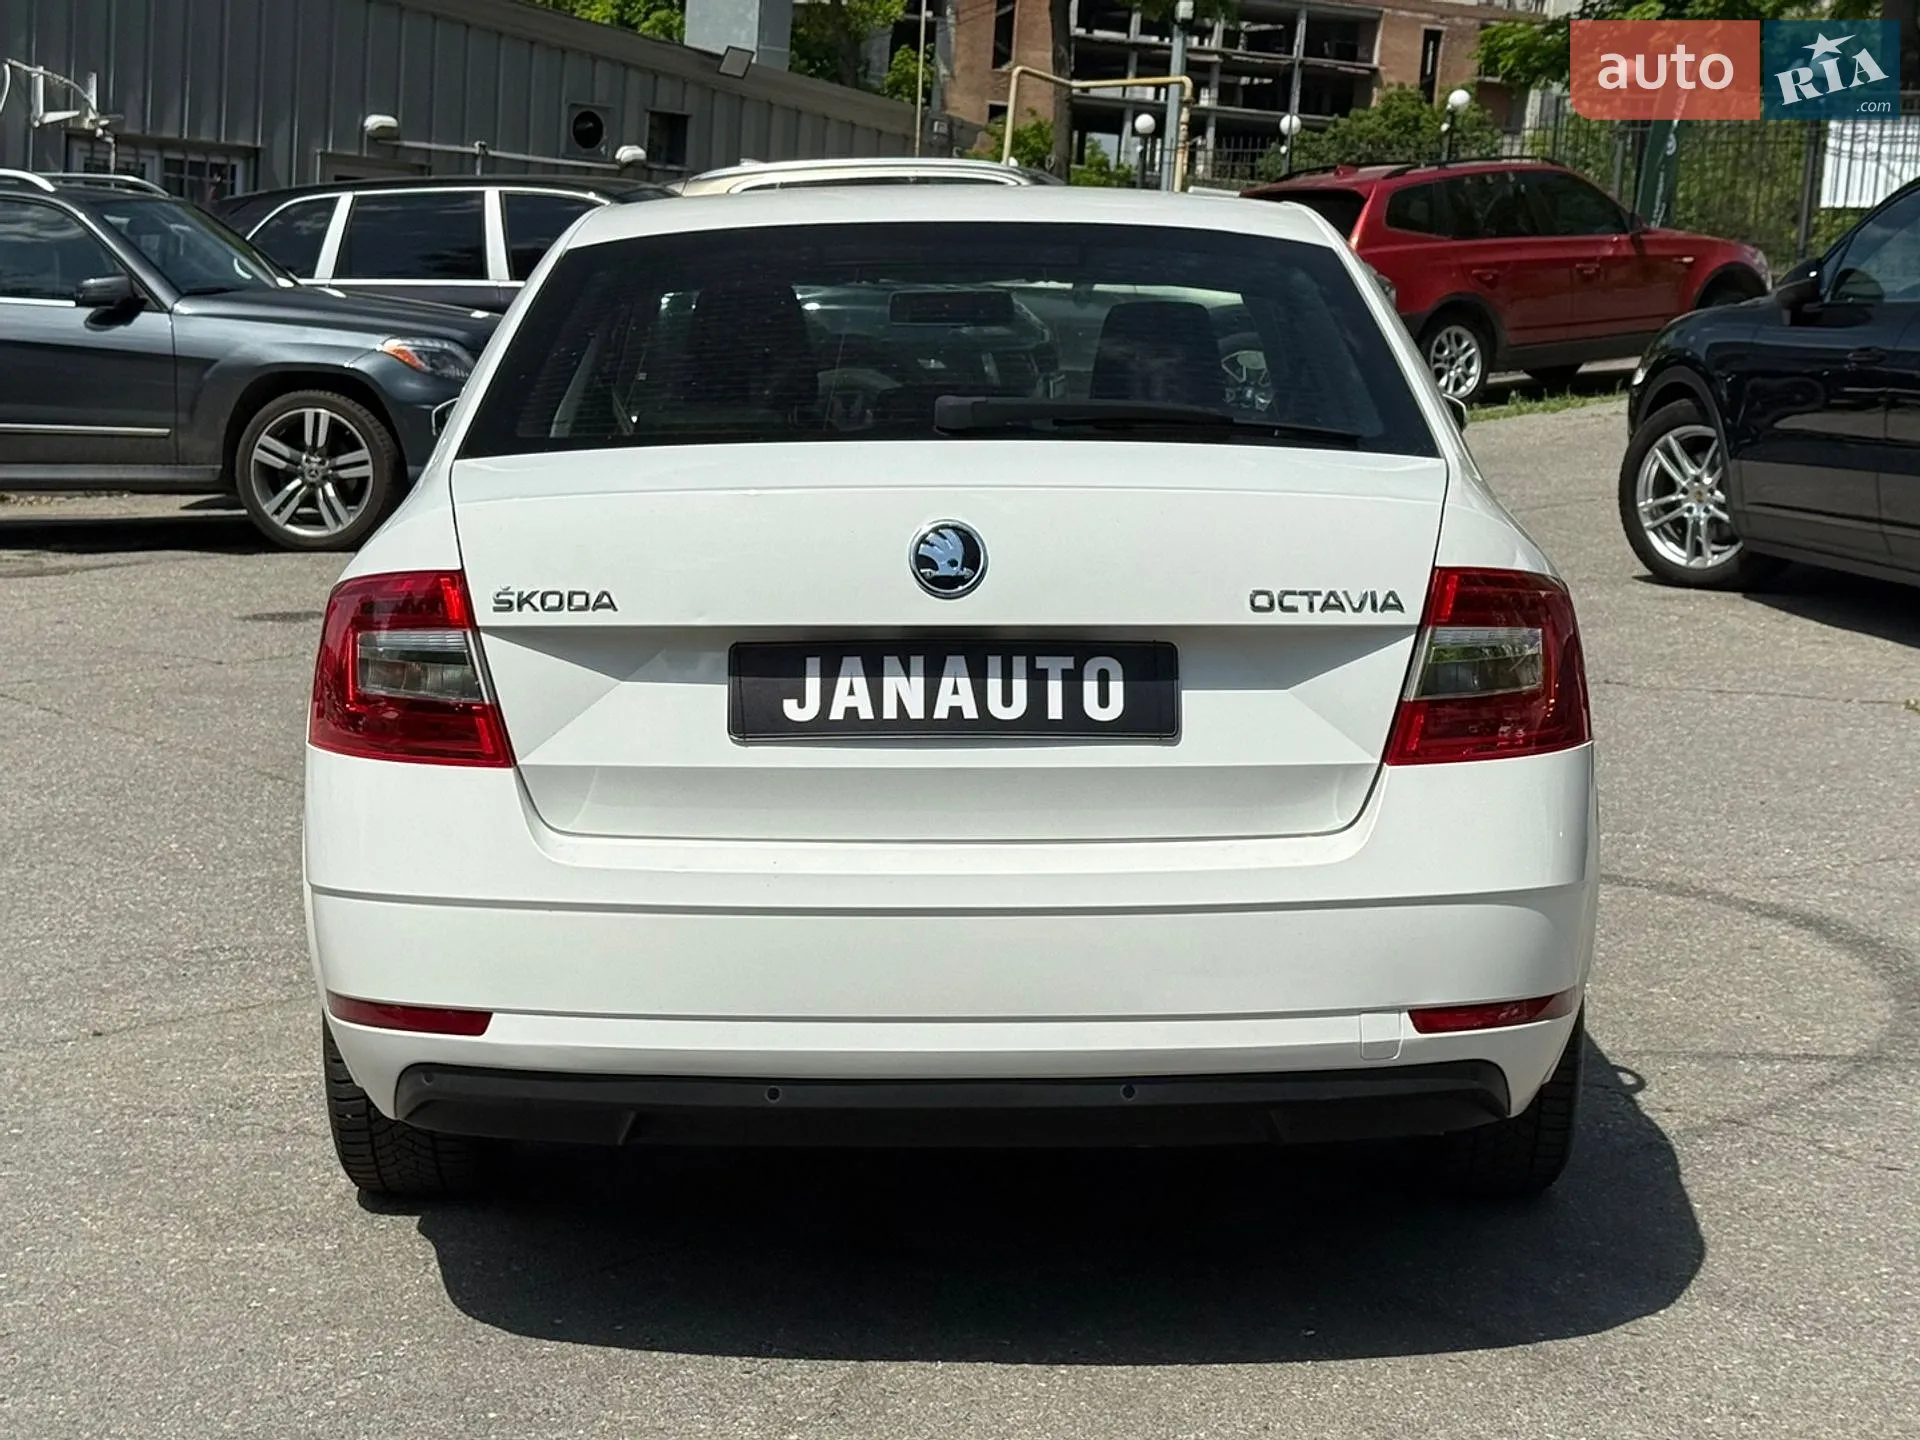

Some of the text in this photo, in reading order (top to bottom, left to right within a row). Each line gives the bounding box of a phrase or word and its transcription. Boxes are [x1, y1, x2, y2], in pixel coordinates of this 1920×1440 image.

[492, 586, 618, 612] ŠKODA
[1249, 590, 1405, 613] OCTAVIA
[782, 655, 1125, 722] JANAUTO
